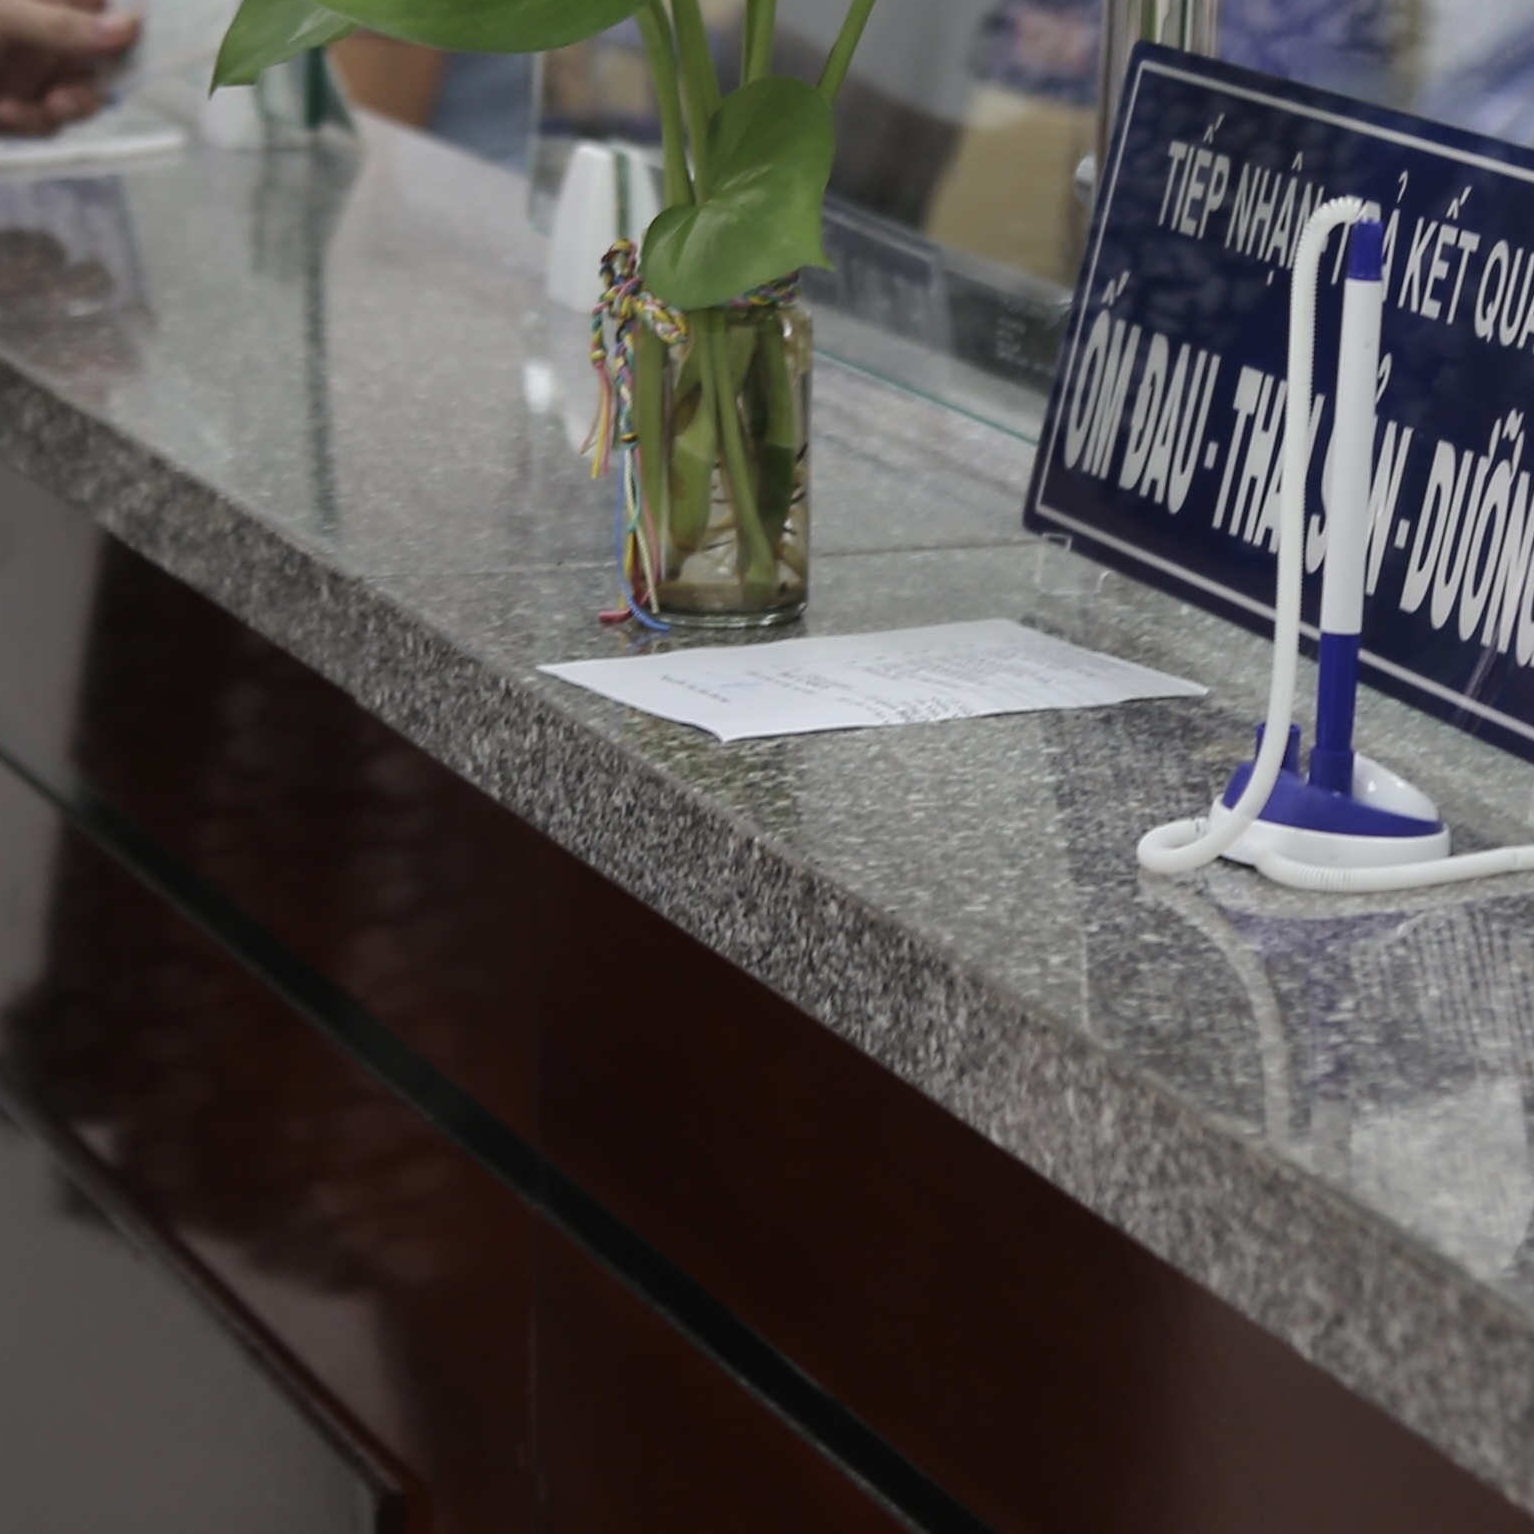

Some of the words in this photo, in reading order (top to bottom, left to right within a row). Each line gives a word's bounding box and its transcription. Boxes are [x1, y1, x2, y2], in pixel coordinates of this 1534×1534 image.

[1162, 114, 1229, 240] TIẾP
[1398, 186, 1479, 326] KẾT
[1062, 269, 1141, 480] ỐM
[1118, 330, 1219, 516] ĐAU
